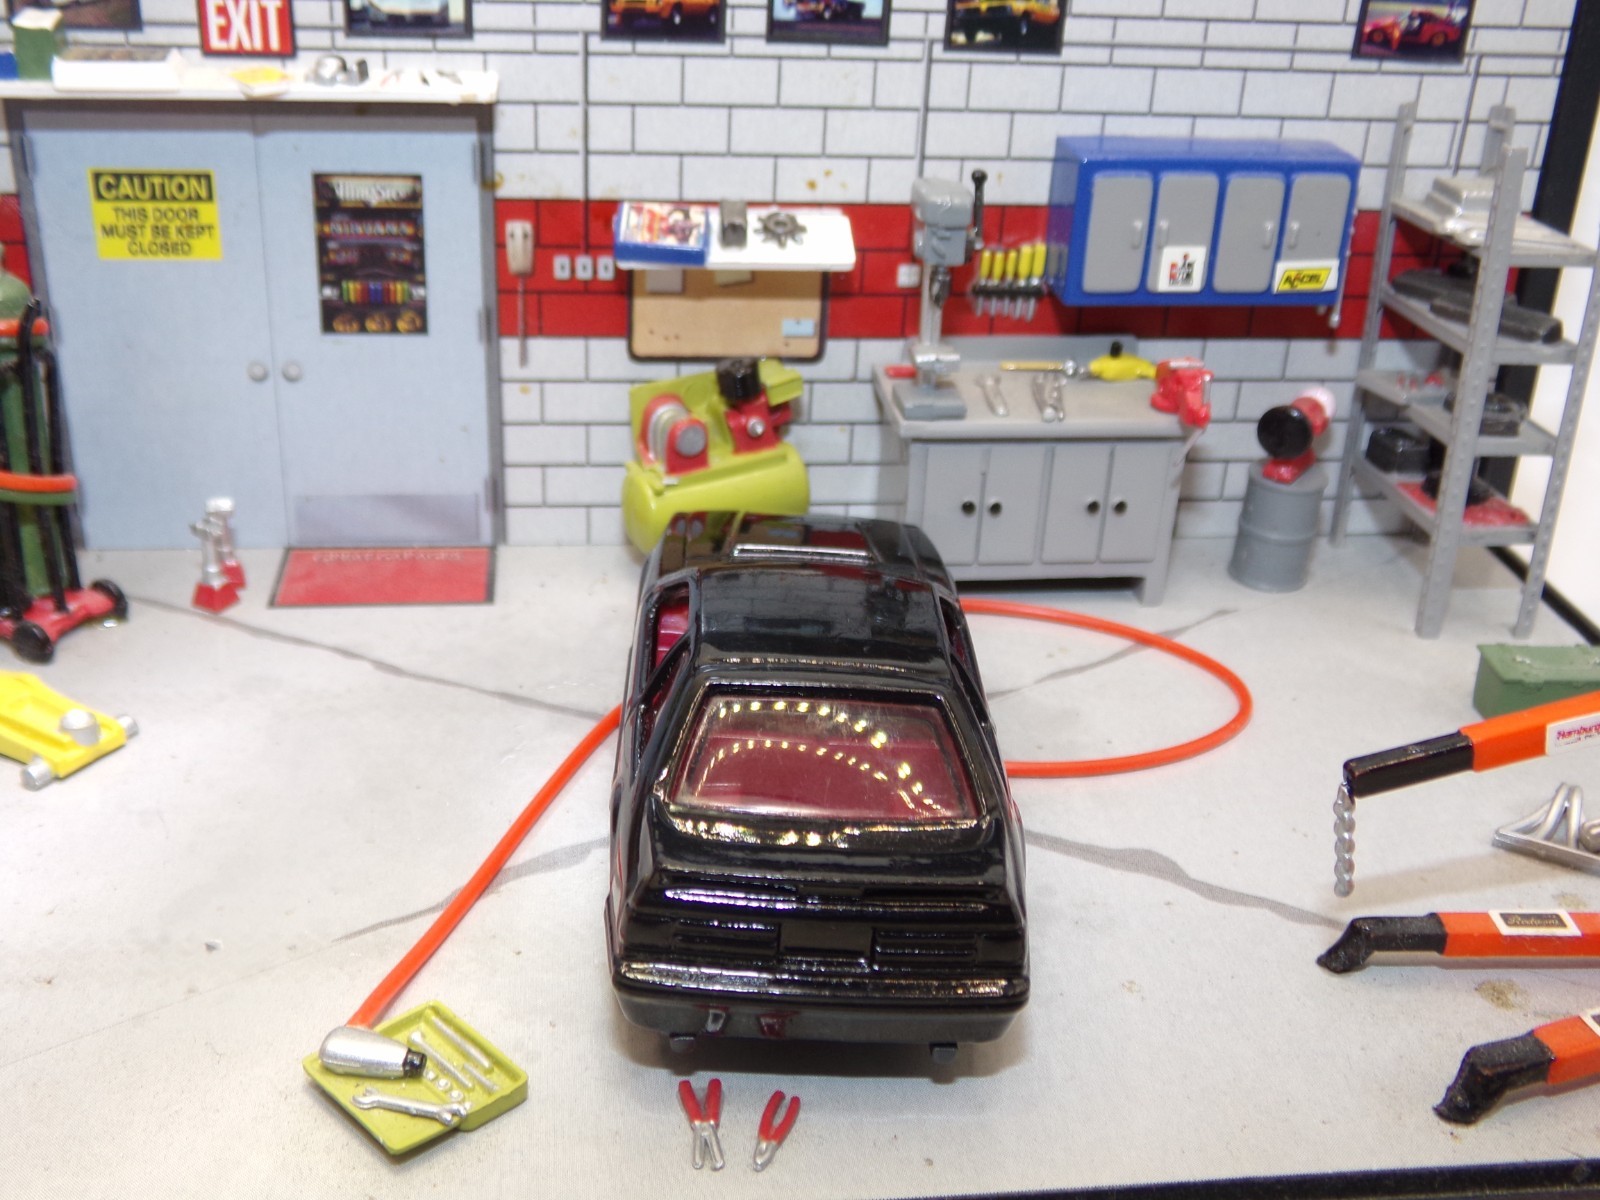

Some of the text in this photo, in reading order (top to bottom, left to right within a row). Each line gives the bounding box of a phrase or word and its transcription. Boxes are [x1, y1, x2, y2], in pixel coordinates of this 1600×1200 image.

[205, 0, 281, 51] EXIT
[98, 175, 208, 200] CAUTION
[112, 207, 199, 222] THIS DOOR
[101, 224, 214, 240] MUST BE KEPT
[127, 241, 192, 256] CLOSED
